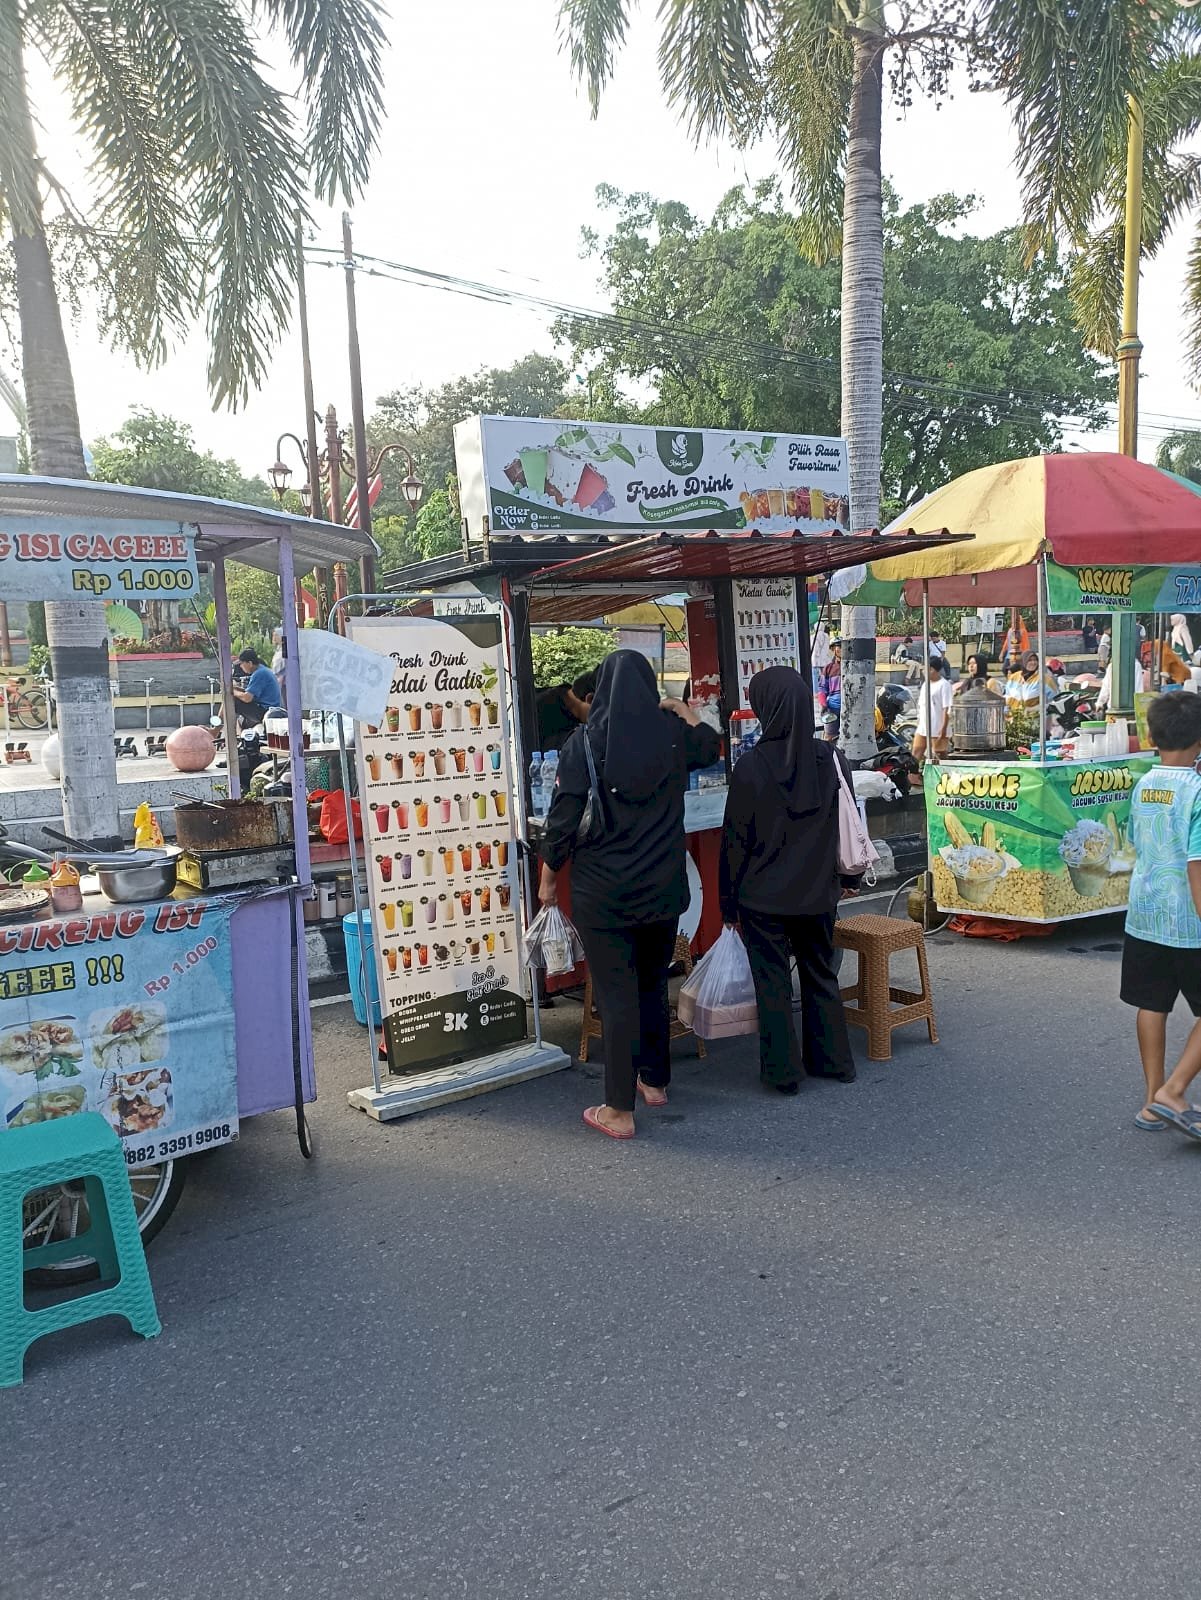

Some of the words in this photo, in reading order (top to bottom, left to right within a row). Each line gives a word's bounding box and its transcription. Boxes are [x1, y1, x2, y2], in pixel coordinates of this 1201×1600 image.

[788, 443, 812, 456] Pilih
[814, 444, 840, 457] Rasa
[788, 457, 841, 472] Favoritmu!
[626, 479, 679, 503] Fresh
[684, 473, 734, 498] Drink
[494, 505, 530, 516] Order
[500, 515, 527, 530] Now
[16, 533, 62, 561] ISI
[64, 533, 188, 562] GAGEEE
[72, 569, 111, 595] Rp
[118, 568, 194, 590] 1.000
[1078, 567, 1134, 596] JASUKE
[429, 650, 469, 667] Drink
[389, 672, 428, 694] edai
[434, 668, 486, 692] Gadis
[936, 772, 1021, 800] JASUKE
[1070, 766, 1133, 797] JASUKE
[936, 797, 966, 808] JAGUNG
[968, 799, 992, 810] SUSU
[994, 801, 1019, 812] KEJU
[1072, 796, 1096, 808] JAGUNG
[1097, 794, 1113, 805] SUSU
[1114, 792, 1130, 803] KEJU
[1141, 788, 1175, 805] KENZIE
[0, 907, 146, 954] CIRENG
[152, 902, 208, 933] ISI
[85, 953, 125, 987] !!!
[143, 974, 171, 998] Rp
[171, 935, 218, 975] 1.000
[472, 971, 486, 987] Ice
[443, 1012, 469, 1033] 3K
[401, 1035, 416, 1044] JELLY
[123, 1145, 155, 1165] 882
[159, 1133, 193, 1156] 3391
[195, 1123, 231, 1146] 9908
